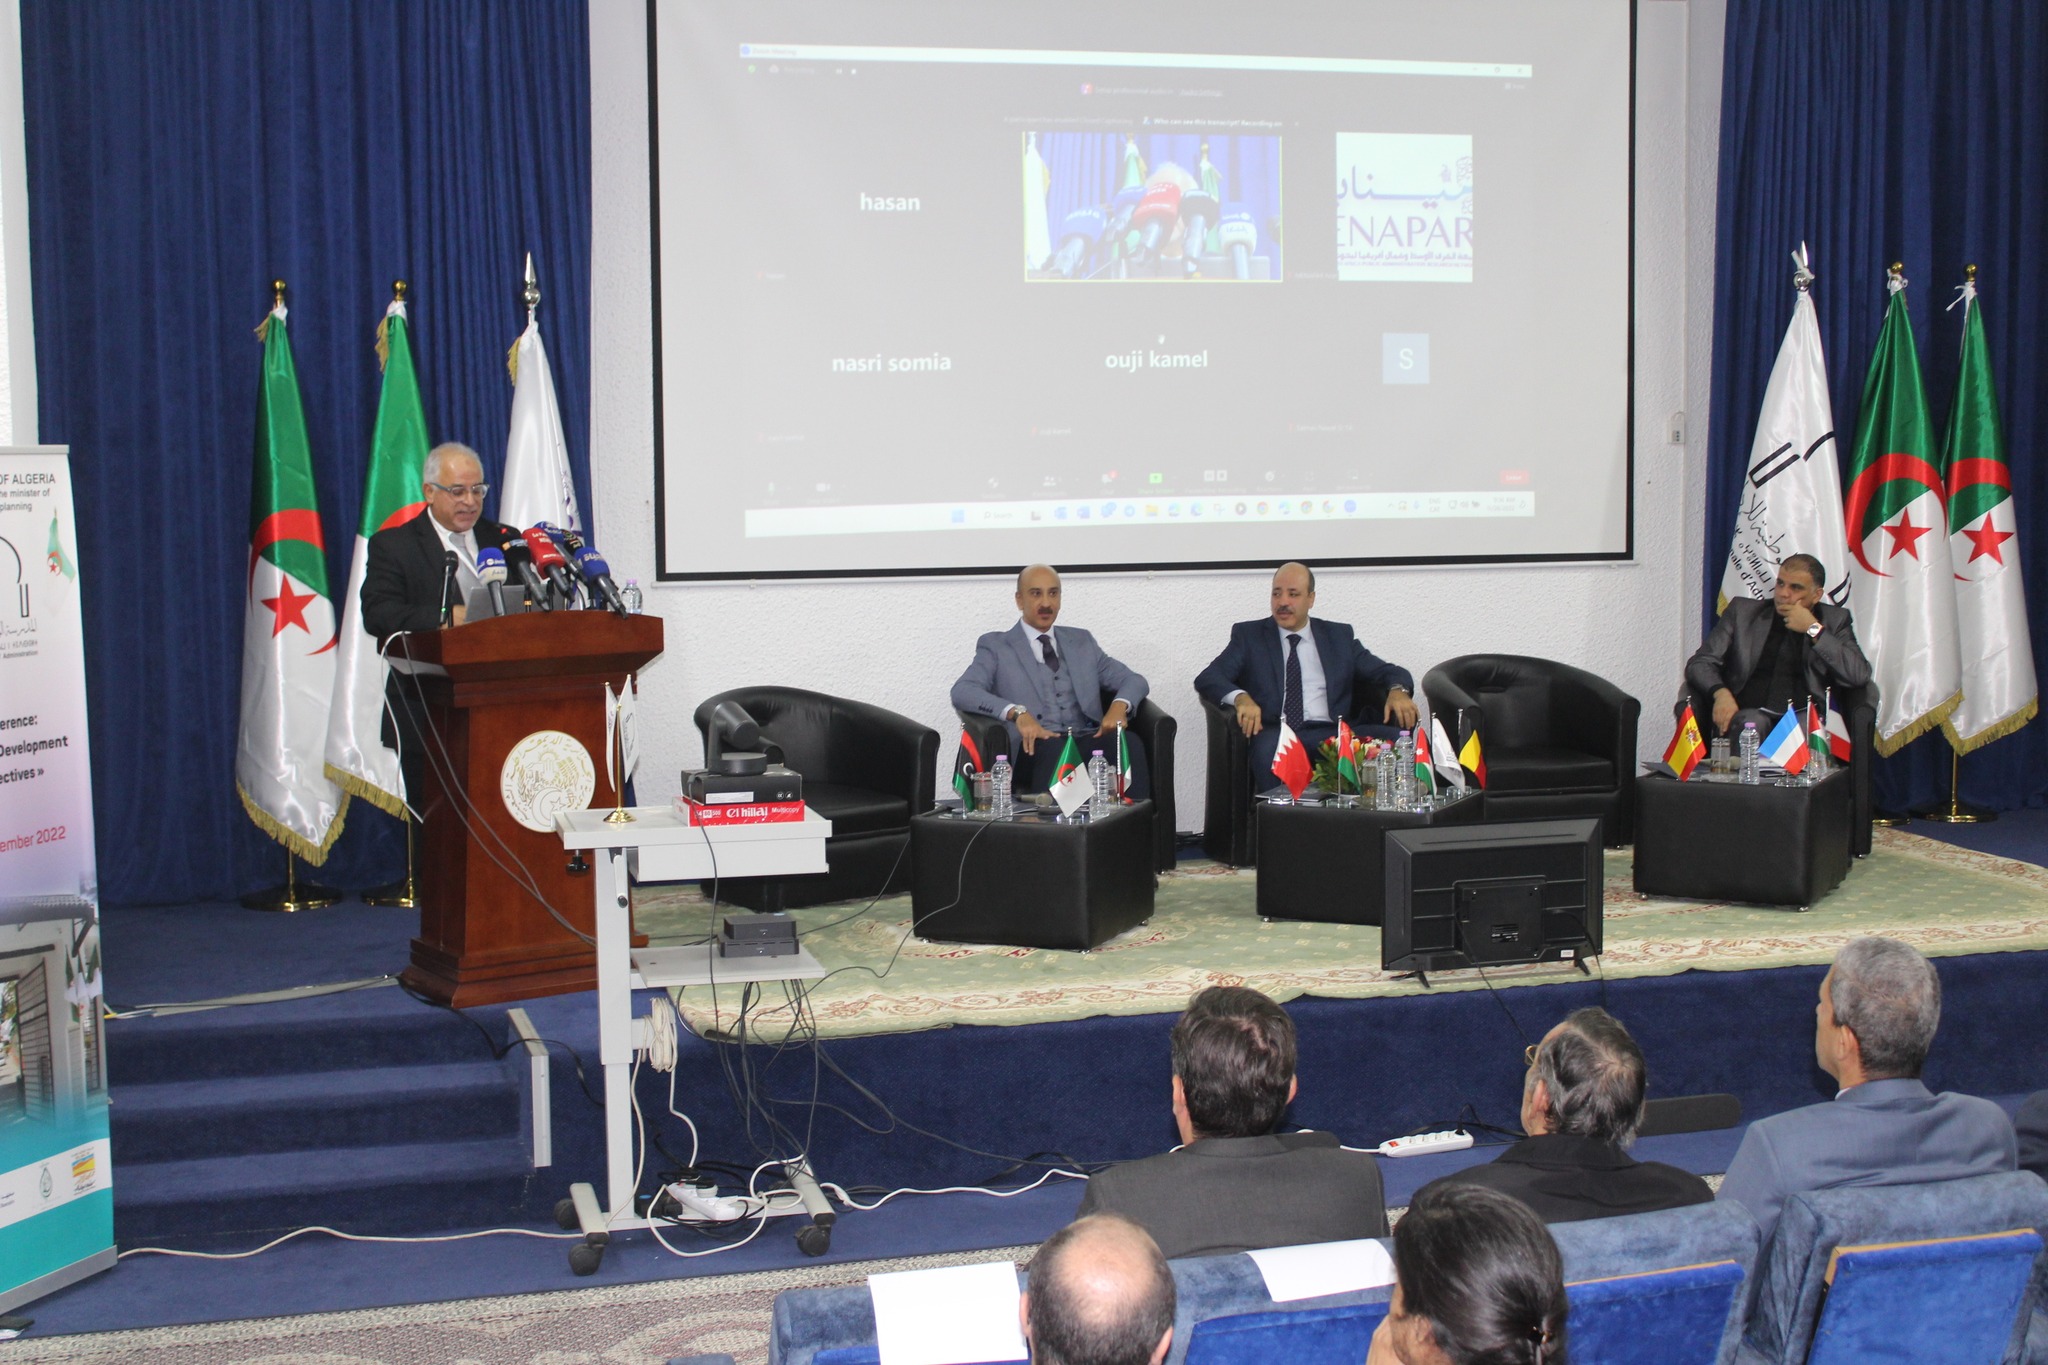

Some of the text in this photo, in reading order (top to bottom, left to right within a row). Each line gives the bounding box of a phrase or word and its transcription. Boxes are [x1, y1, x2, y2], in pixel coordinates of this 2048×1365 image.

[860, 193, 921, 211] hasan
[832, 352, 952, 372] nasri somia
[1105, 350, 1208, 373] ouji kamel
[1399, 348, 1414, 371] S
[12, 473, 56, 485] ALGERIA
[10, 488, 41, 497] minister
[42, 487, 50, 497] of
[36, 825, 66, 845] 2022
